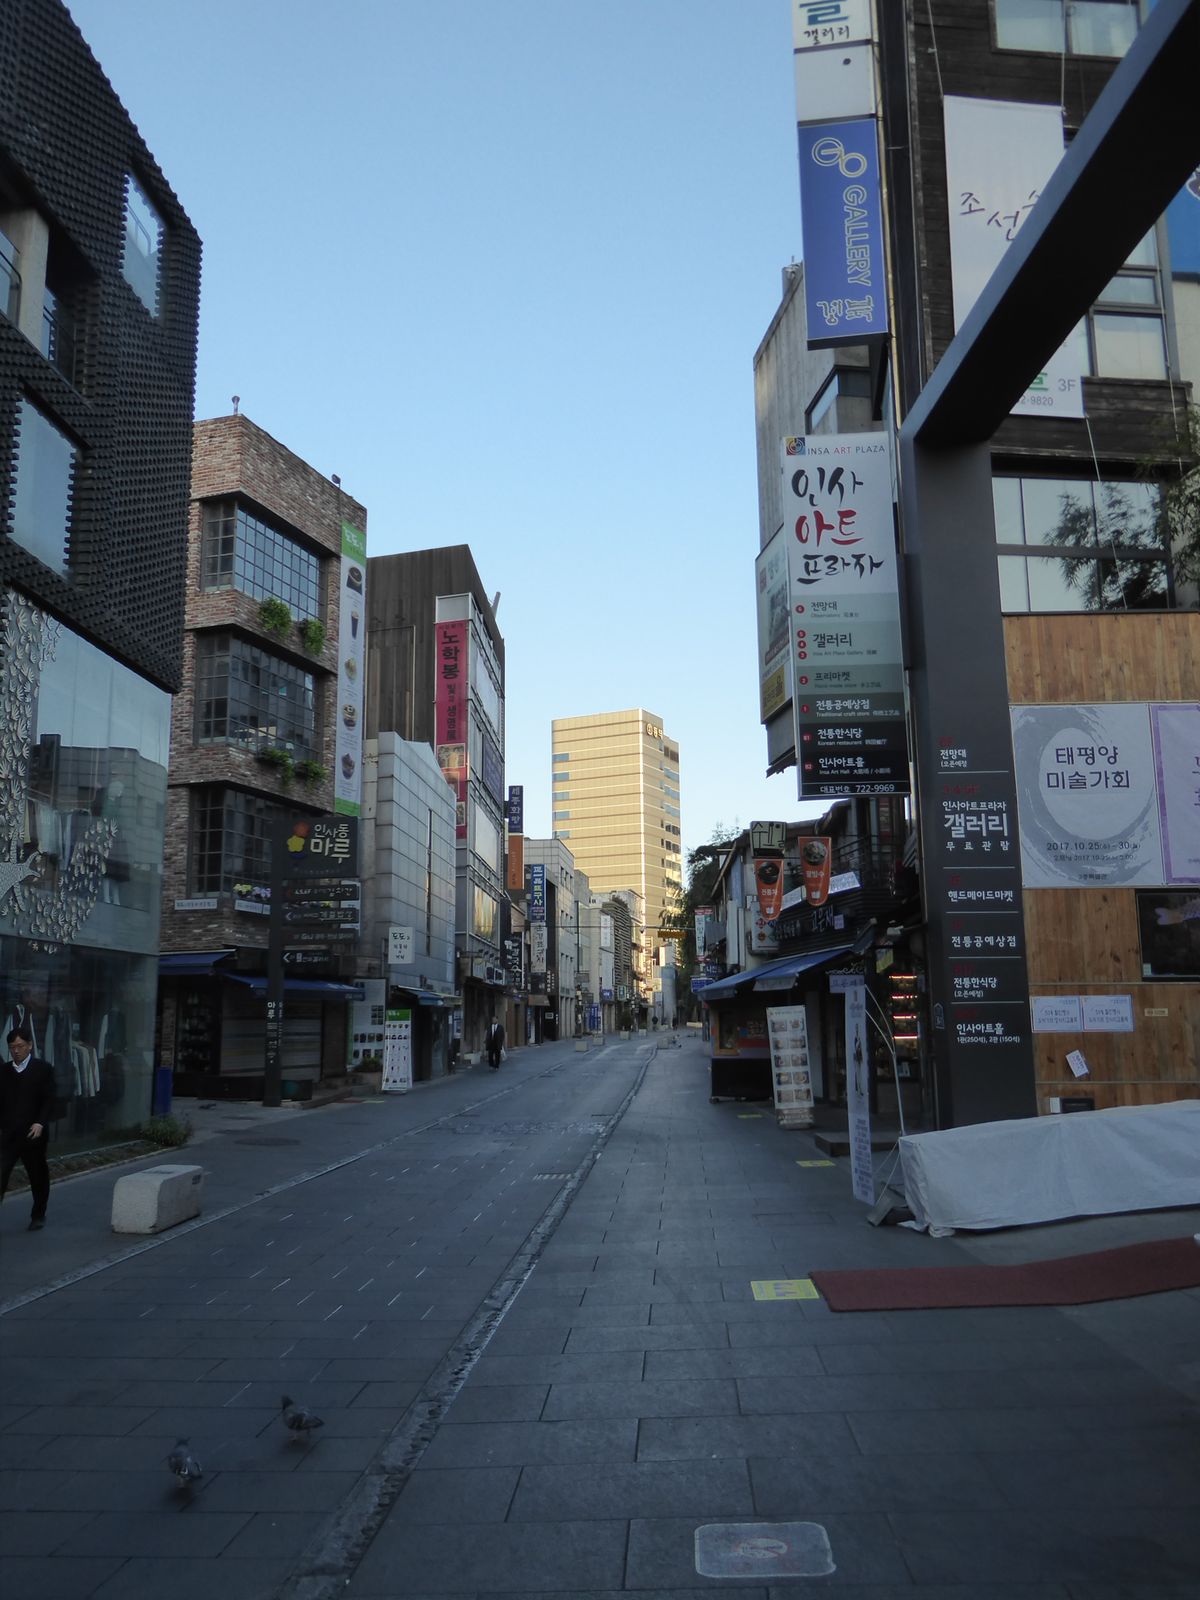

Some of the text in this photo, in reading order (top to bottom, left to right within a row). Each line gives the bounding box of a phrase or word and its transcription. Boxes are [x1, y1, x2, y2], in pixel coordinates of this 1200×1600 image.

[804, 25, 849, 45] 갤러리
[843, 184, 871, 287] GALLERY
[1058, 378, 1076, 392] 3F
[808, 444, 886, 456] INSA ART PLAZA
[791, 466, 864, 507] 인사
[795, 510, 864, 547] 아트
[796, 553, 884, 585] 프라자
[811, 601, 838, 612] 전망대
[813, 632, 852, 648] 갤러리
[815, 671, 850, 681] 프리마켓
[816, 699, 870, 711] 전통공예상점
[817, 728, 862, 739] 전통한식당
[940, 749, 967, 760] 전망대
[1055, 745, 1118, 766] 태평양
[818, 756, 865, 768] 인사아트홀
[1046, 770, 1130, 789] 미술가회
[820, 784, 895, 793] 대표번호 722-9969
[942, 801, 1007, 811] 인사아트프라자
[314, 823, 349, 838] 인사동
[944, 813, 1008, 838] 갤러리
[310, 838, 351, 864] 마루
[948, 890, 1013, 902] 핸드메이드마켓
[951, 935, 1016, 948] 전통공예상점
[953, 977, 997, 989] 전통한식당
[956, 1022, 1004, 1035] 인사아트홀
